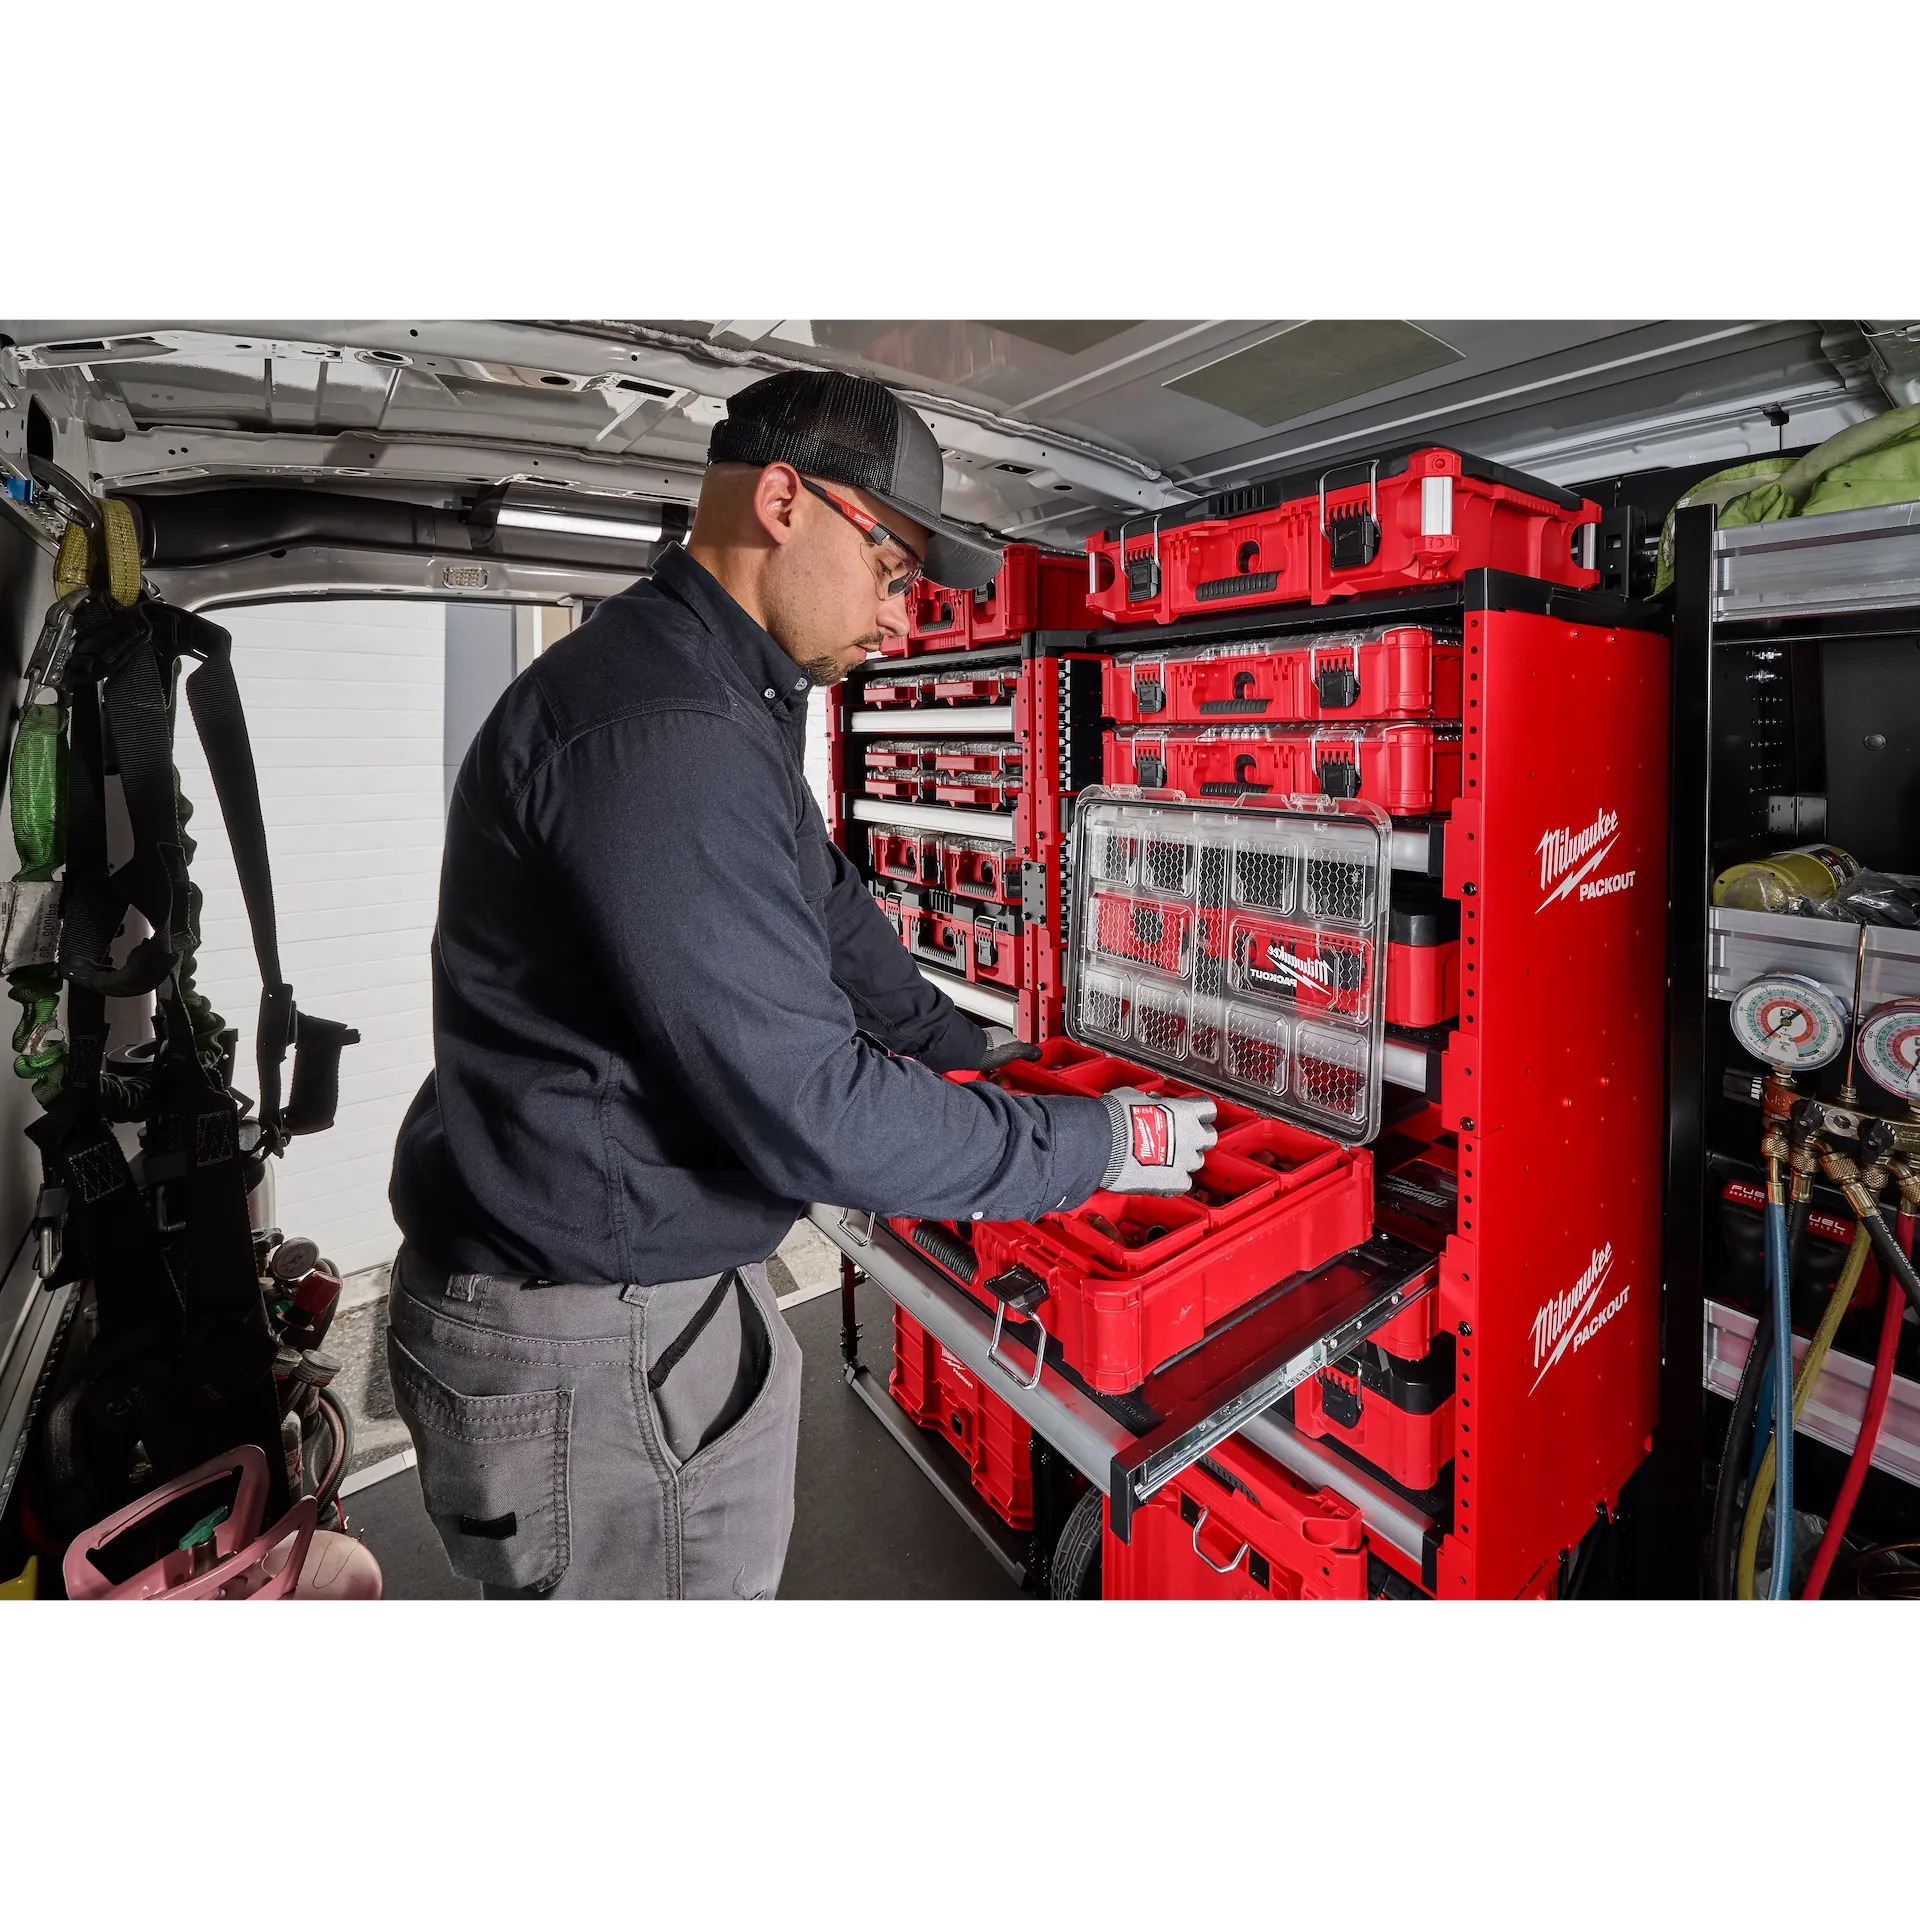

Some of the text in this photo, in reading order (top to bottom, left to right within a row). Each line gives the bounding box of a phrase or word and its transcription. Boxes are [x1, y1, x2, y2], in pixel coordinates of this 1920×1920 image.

[1534, 807, 1619, 891] Milwaukee
[1579, 870, 1636, 902] PACKOUT
[1135, 1116, 1152, 1160] Milwaukee
[1387, 1174, 1422, 1190] PACKO
[1731, 1184, 1765, 1199] FUE
[1729, 1190, 1763, 1203] BRUSHLE
[1808, 1214, 1846, 1232] UEL
[1809, 1221, 1845, 1236] SHLESS
[1528, 1241, 1613, 1369] Milwaukee
[1573, 1285, 1631, 1353] PACKOUT
